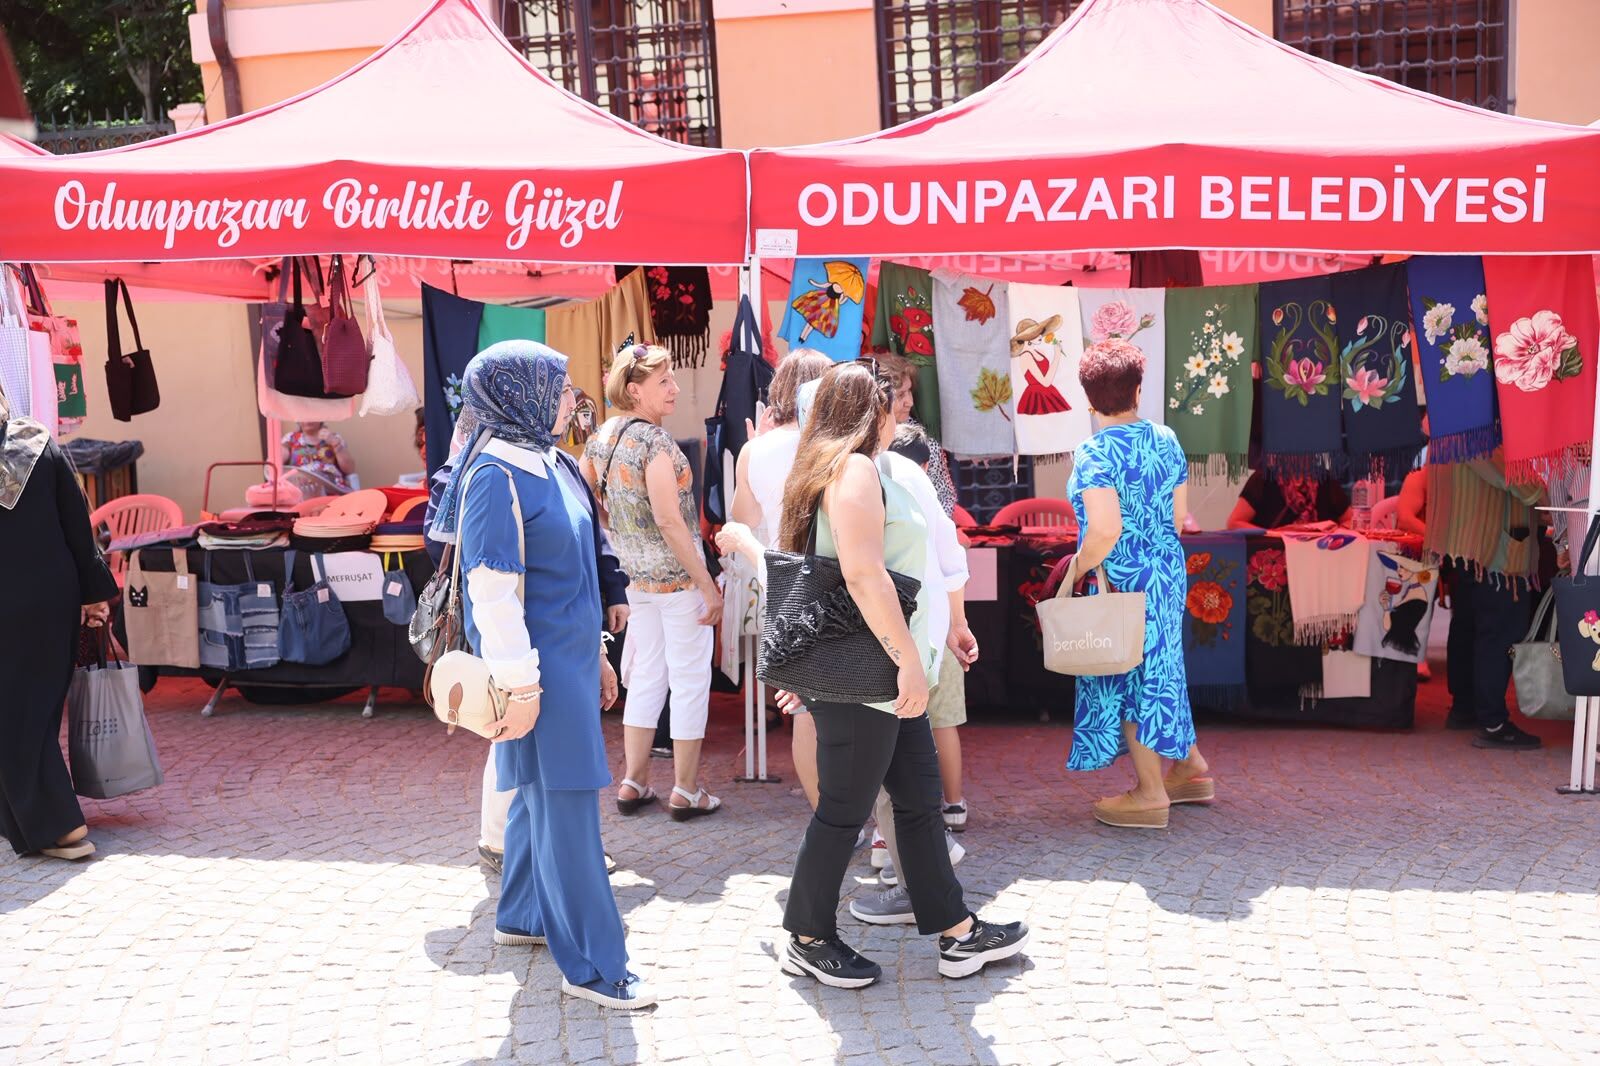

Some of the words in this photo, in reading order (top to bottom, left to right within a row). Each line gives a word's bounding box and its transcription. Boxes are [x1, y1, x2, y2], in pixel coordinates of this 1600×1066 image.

[54, 180, 308, 249] Odunpazarı
[322, 178, 492, 230] Birlikte
[505, 179, 624, 250] Güzel
[797, 175, 1175, 227] ODUNPAZARI
[1200, 164, 1547, 223] BELEDİYESİ
[327, 572, 374, 583] MEFRUŞAT
[1053, 631, 1112, 652] benetton
